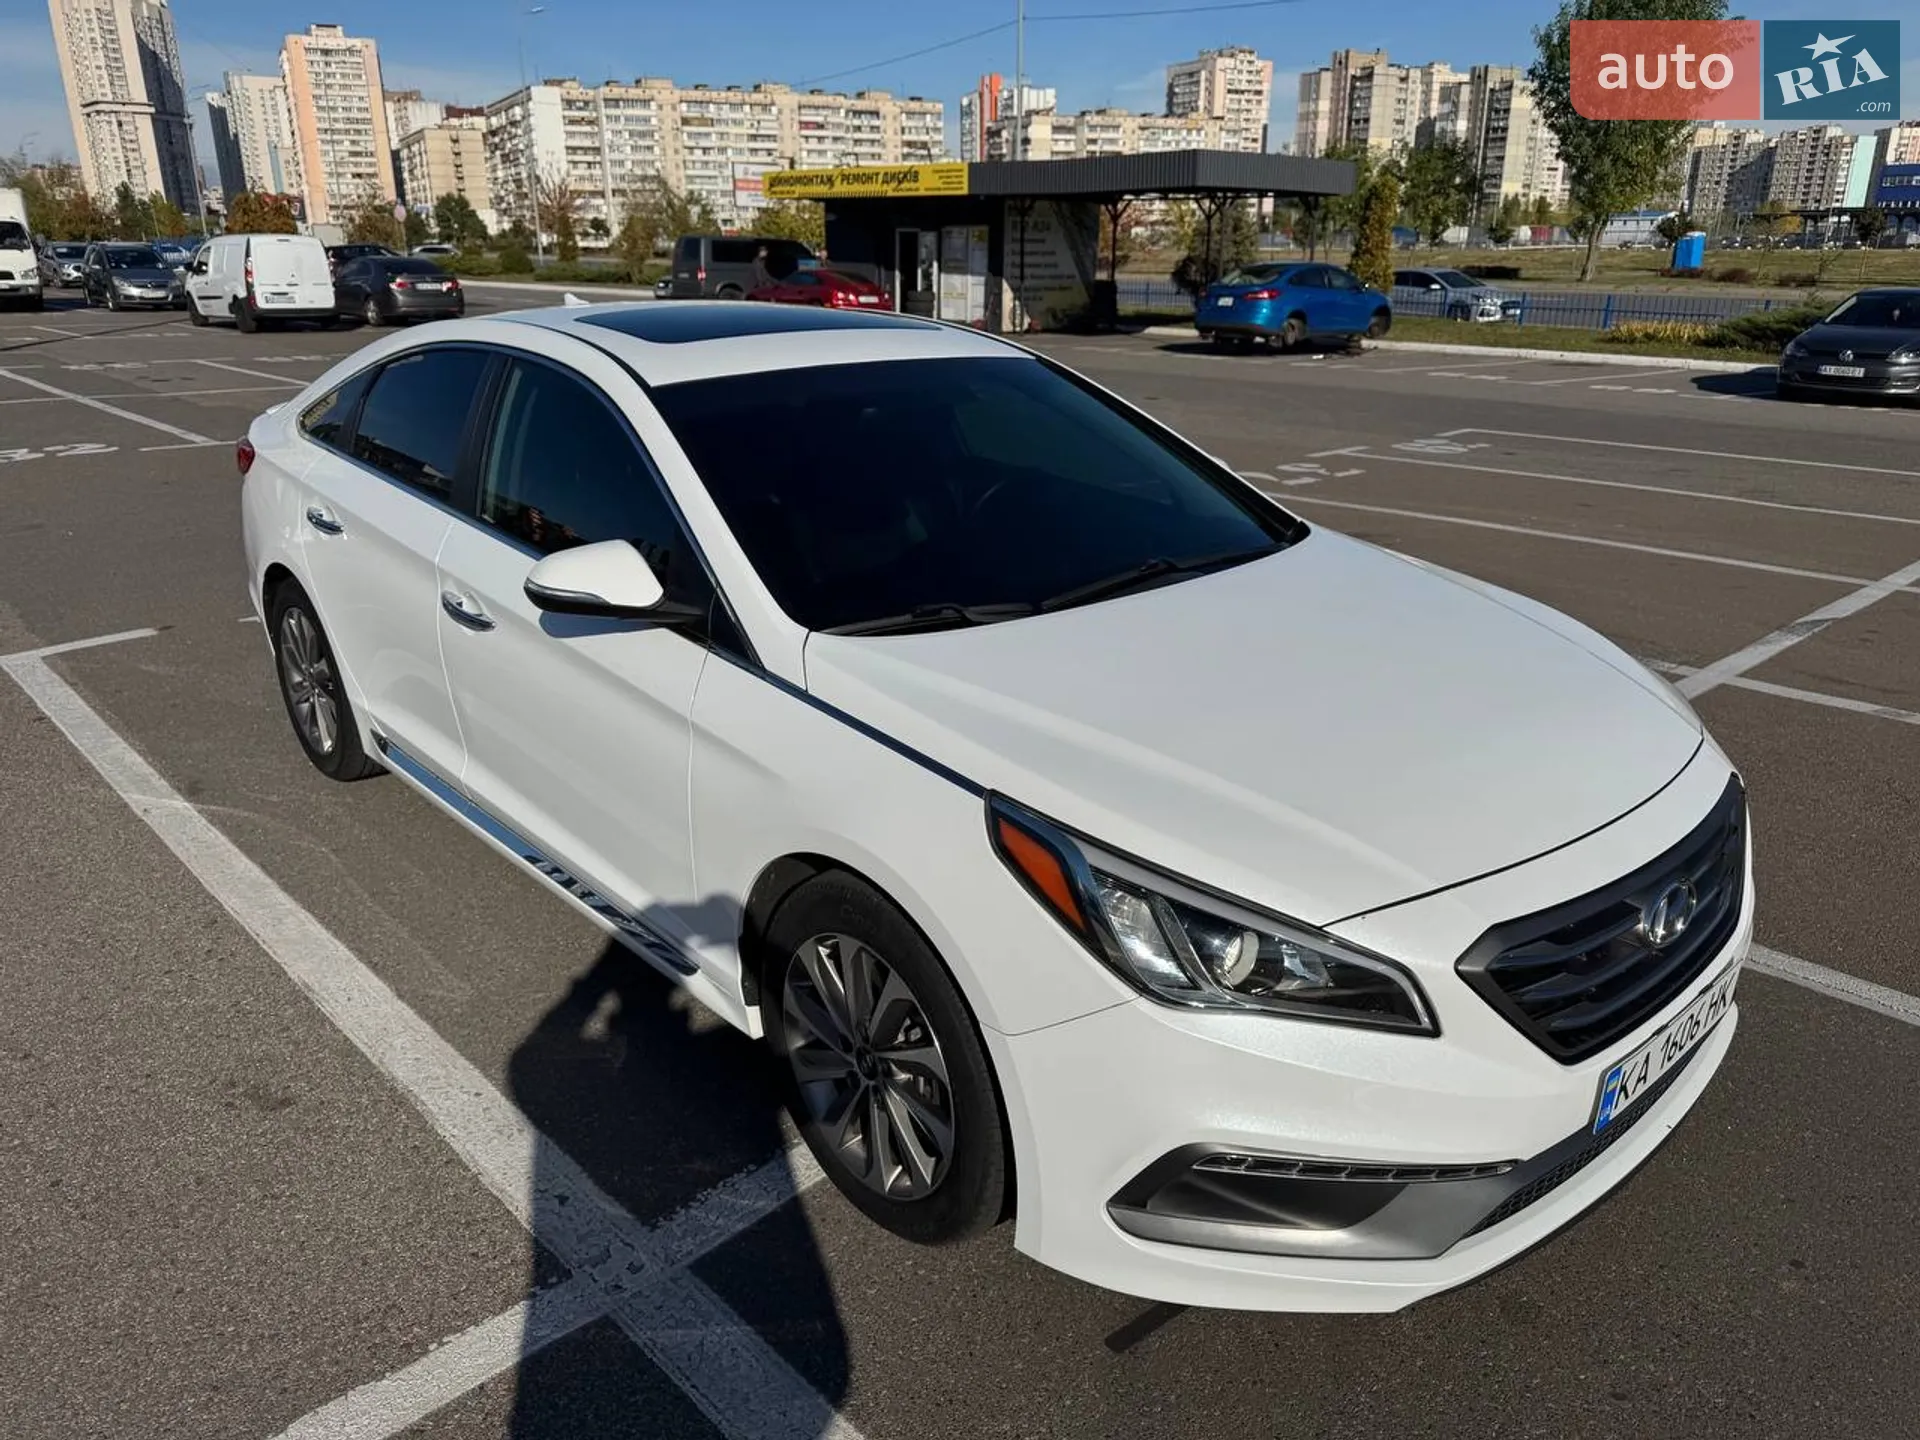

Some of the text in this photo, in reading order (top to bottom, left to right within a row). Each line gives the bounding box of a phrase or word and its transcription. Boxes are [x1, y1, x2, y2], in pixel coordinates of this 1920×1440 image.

[840, 172, 880, 186] РЕМОНТ
[1614, 972, 1736, 1109] KA 1606 HK
